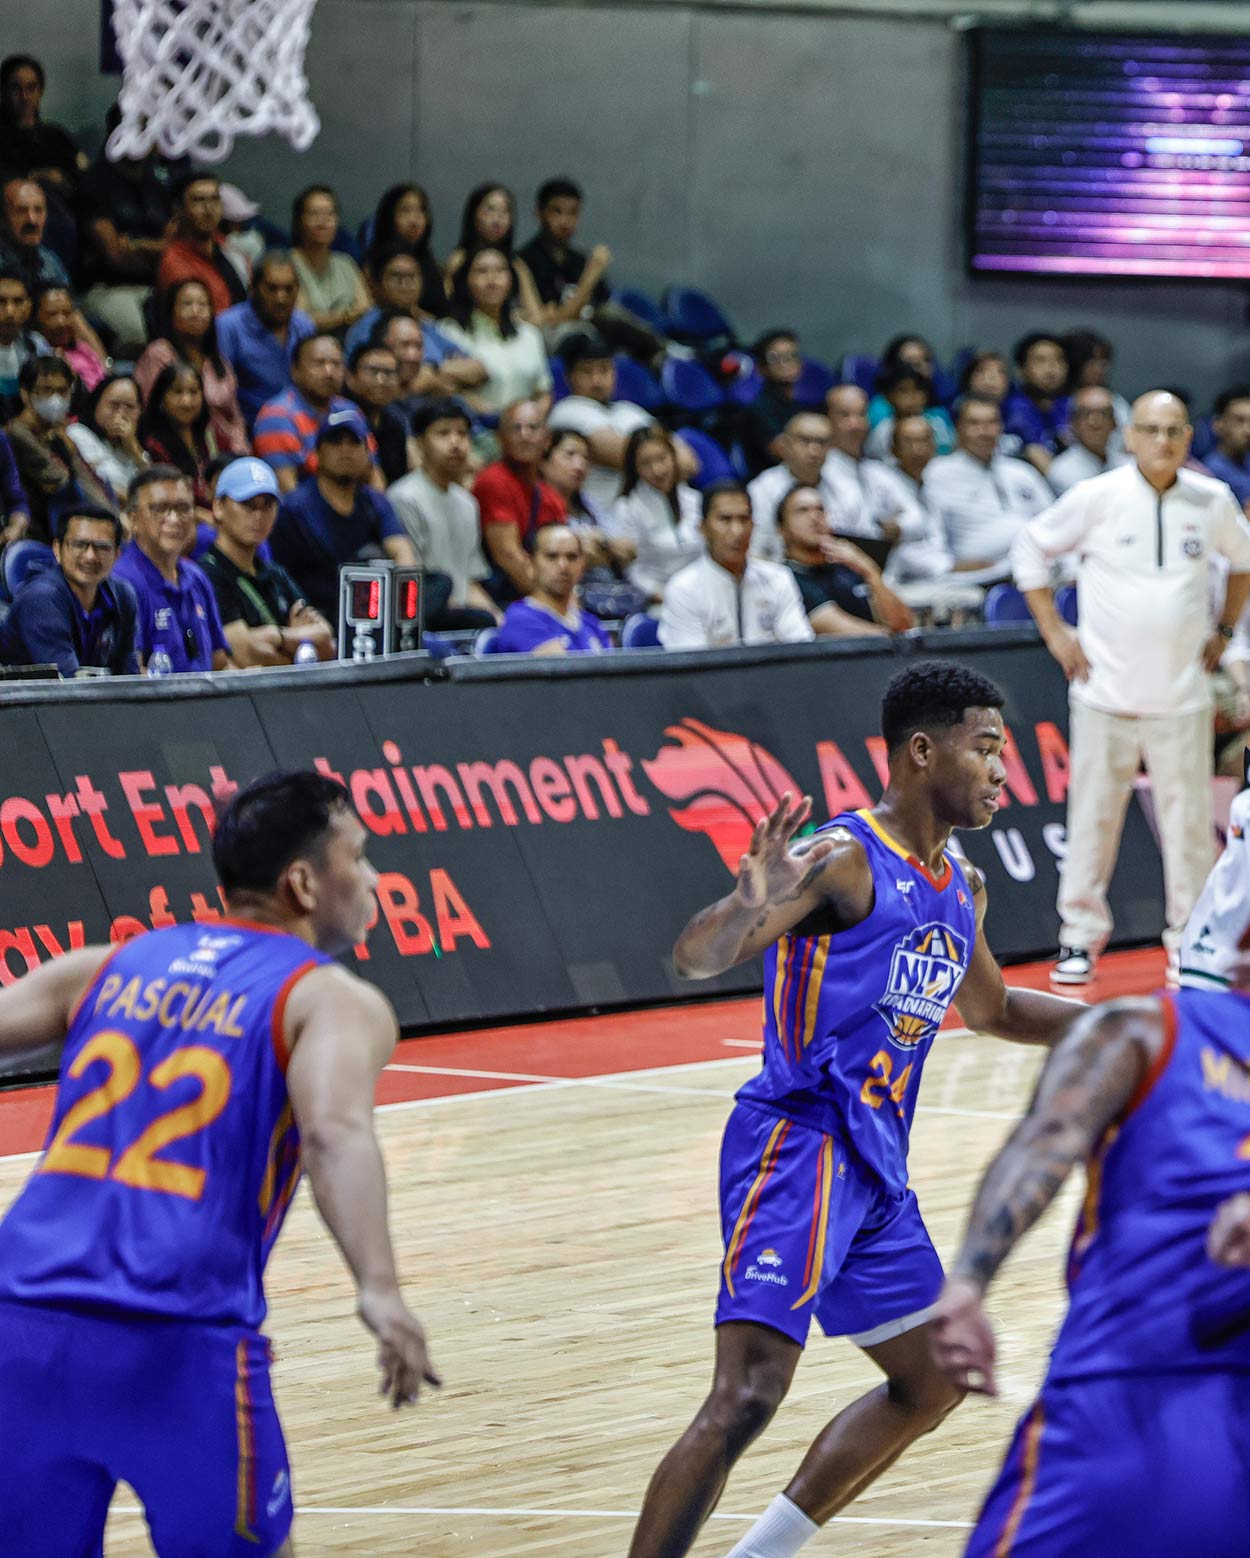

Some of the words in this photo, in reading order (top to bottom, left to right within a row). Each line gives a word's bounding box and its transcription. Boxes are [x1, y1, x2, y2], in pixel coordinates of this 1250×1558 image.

[0, 774, 127, 869] ort
[353, 867, 492, 961] BA
[94, 973, 249, 1037] PASCUAL
[36, 1029, 233, 1200] 22
[859, 1049, 914, 1118] 24
